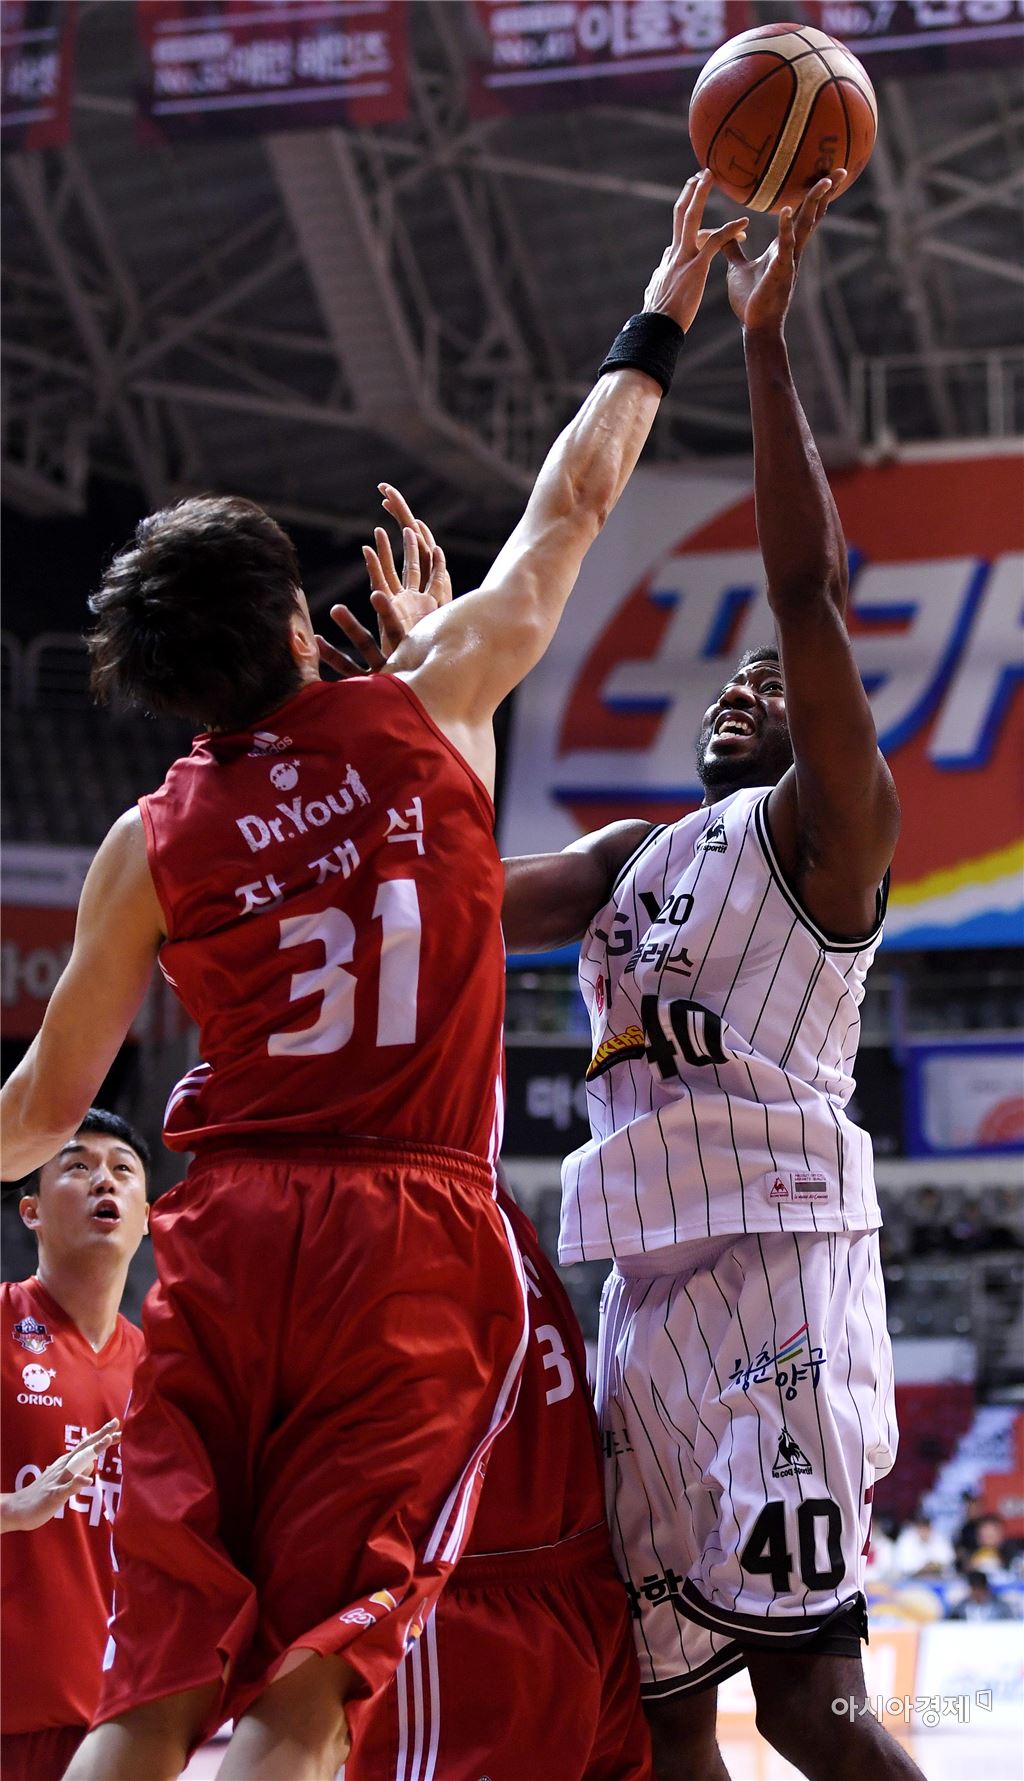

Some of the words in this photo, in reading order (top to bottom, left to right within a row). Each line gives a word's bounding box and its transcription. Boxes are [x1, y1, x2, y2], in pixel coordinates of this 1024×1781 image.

[235, 788, 355, 853] Dr.You
[267, 878, 423, 1058] 31
[640, 993, 731, 1081] 40
[16, 1393, 63, 1407] ORION
[780, 1469, 794, 1478] coq
[740, 1498, 847, 1594] 40
